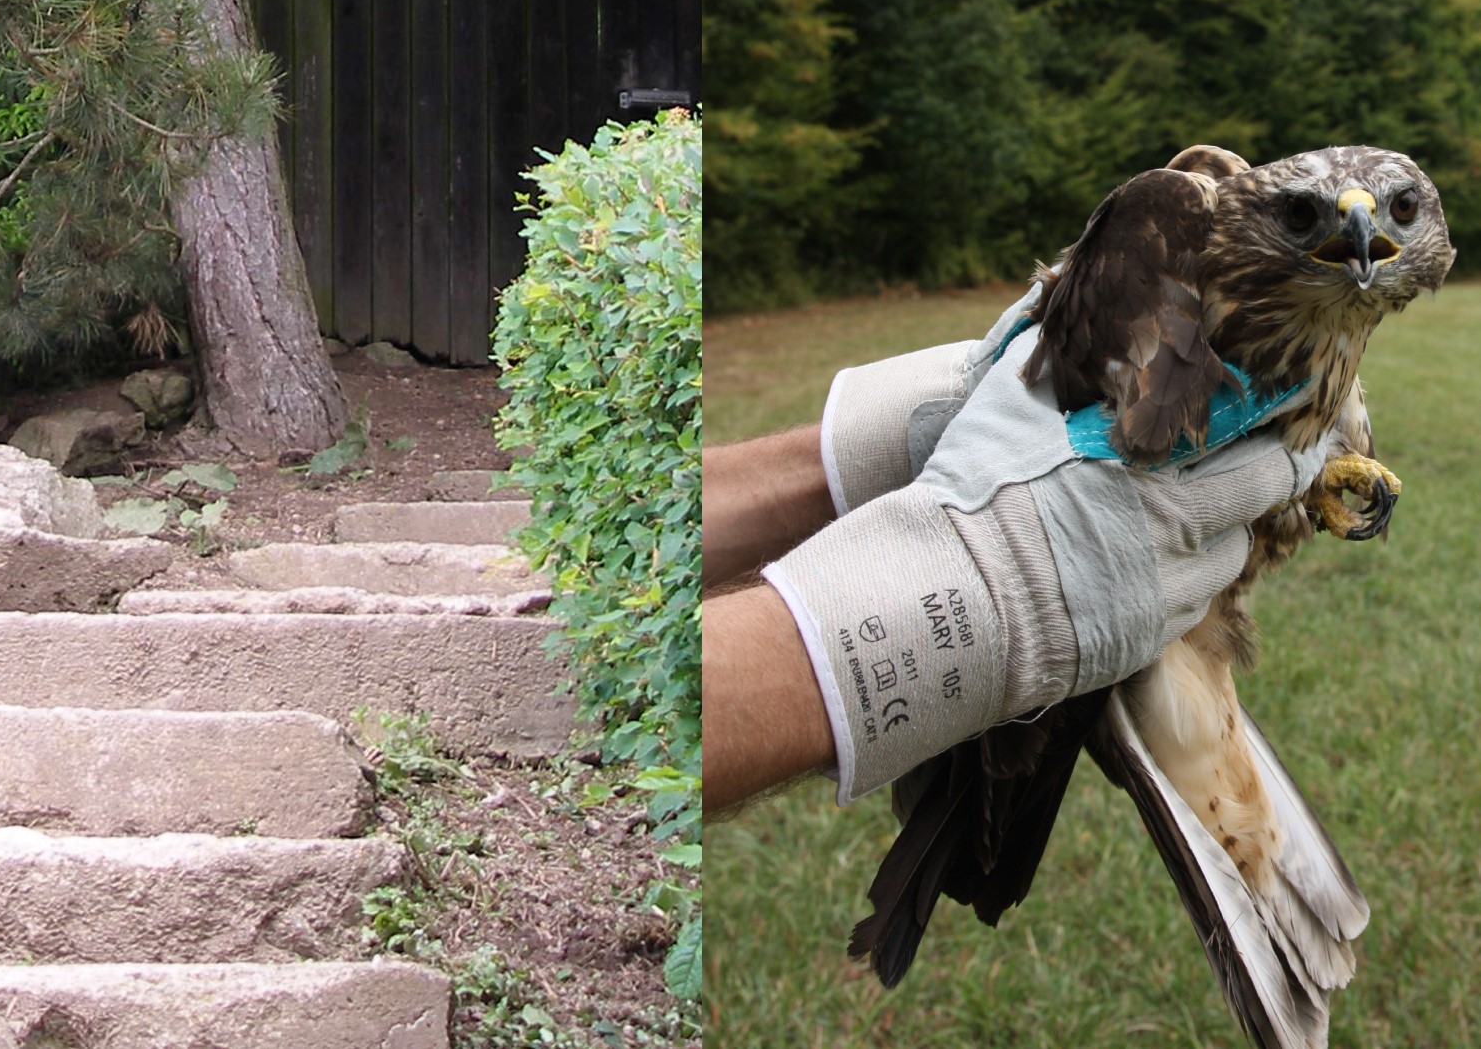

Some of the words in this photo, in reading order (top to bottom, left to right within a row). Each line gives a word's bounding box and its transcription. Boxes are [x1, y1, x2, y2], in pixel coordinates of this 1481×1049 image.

[920, 592, 956, 651] MARY
[945, 588, 975, 648] A285681
[901, 649, 919, 681] 2011
